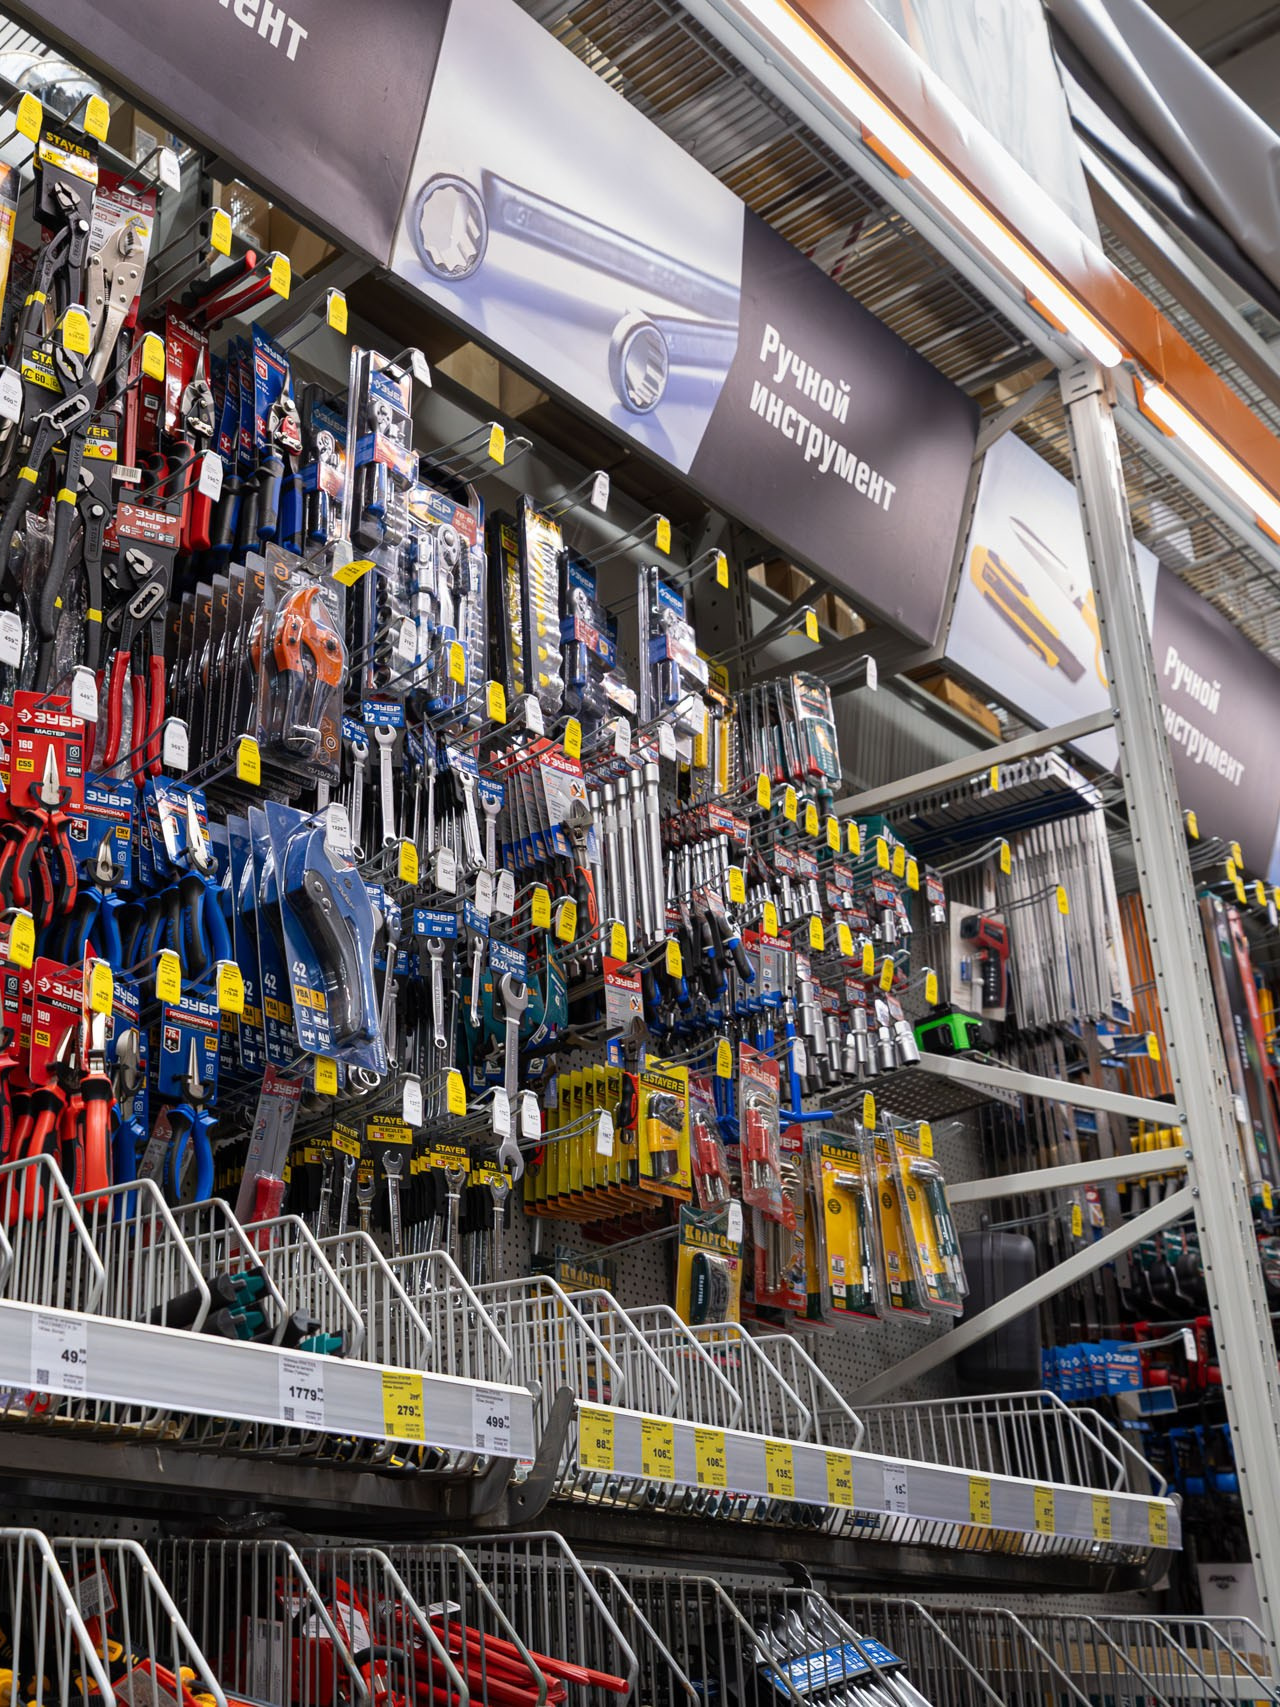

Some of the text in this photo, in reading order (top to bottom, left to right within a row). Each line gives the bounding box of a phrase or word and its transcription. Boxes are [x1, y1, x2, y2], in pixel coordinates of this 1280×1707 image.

[46, 131, 90, 159] STAYER
[111, 191, 153, 212] ЗУБР
[178, 321, 208, 344] ЗУБР
[759, 323, 851, 424] Ручной
[750, 380, 896, 511] инструмент
[135, 508, 177, 524] ЗУБР
[135, 520, 161, 530] МАСТЕР
[1164, 646, 1221, 714] Ручной
[372, 703, 401, 712] ЗУБР
[34, 712, 84, 728] ЗУБР
[363, 713, 375, 722] 12
[34, 727, 65, 737] МАСТЕР
[18, 739, 33, 750] 160
[549, 757, 580, 773] ЗУБР
[87, 790, 132, 807] ЗУБР
[426, 912, 455, 922] ЗУБР
[500, 943, 525, 962] ЗУБР
[293, 961, 307, 978] 42
[264, 973, 277, 990] 42
[614, 975, 640, 990] ЗУБР
[52, 983, 83, 1001] ЗУБ
[114, 982, 139, 1006] ЗУБР
[52, 999, 79, 1013] МАСТЕР
[180, 997, 219, 1016] ЗУБР
[37, 1010, 50, 1021] 180
[272, 1083, 300, 1095] ЗУБР
[649, 1074, 678, 1090] STAYER
[372, 1115, 409, 1126] STAYER
[336, 1123, 359, 1138] STAYER
[435, 1144, 466, 1155] STAYER
[61, 1349, 78, 1363] 49
[288, 1386, 318, 1401] 1779
[397, 1405, 415, 1417] 279
[486, 1415, 504, 1429] 499
[596, 1439, 607, 1449] 88
